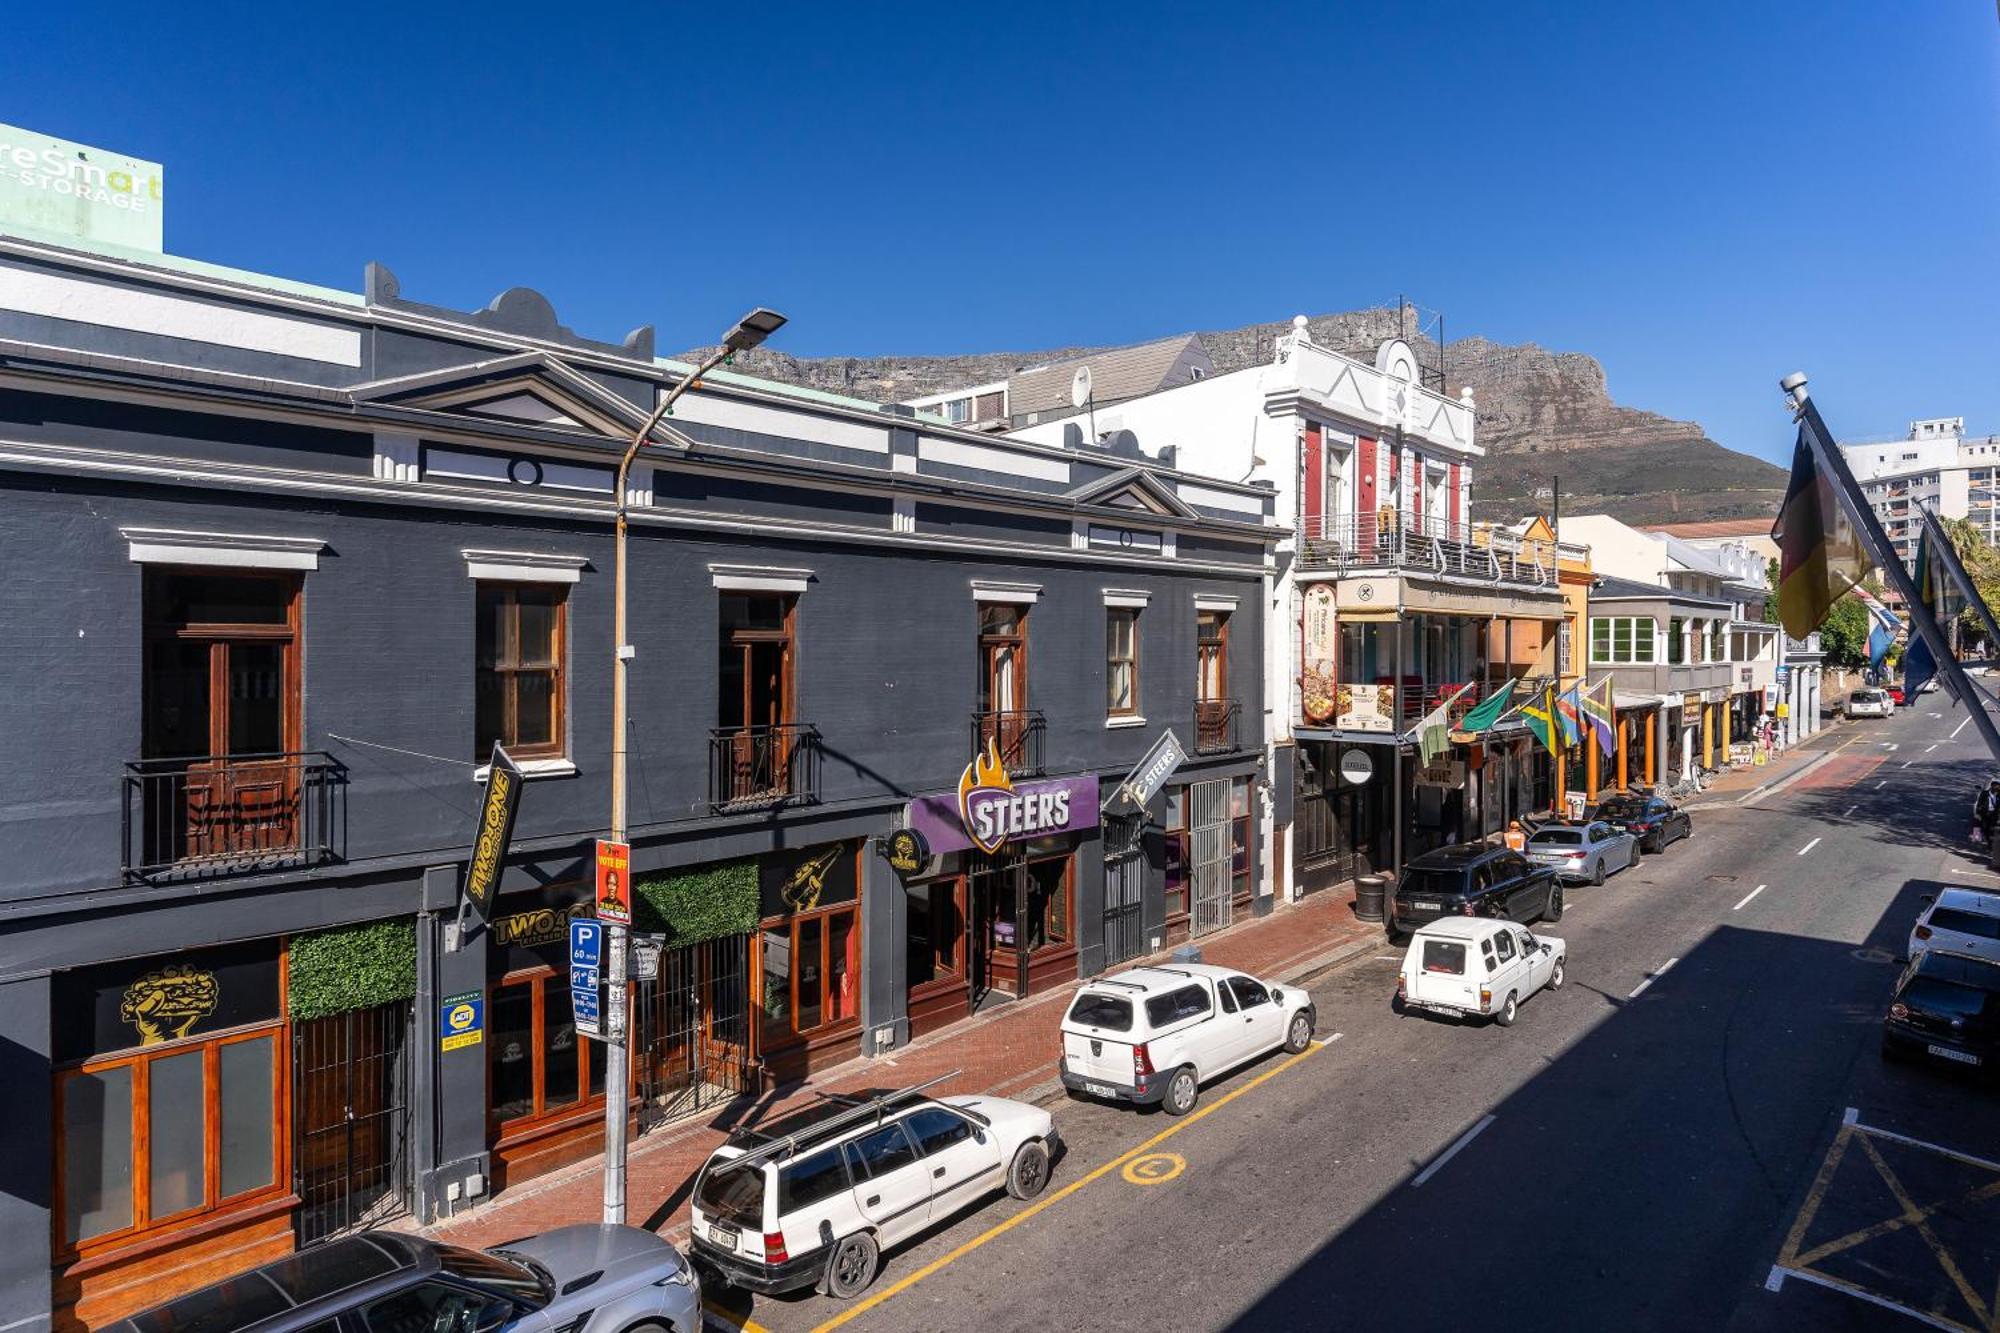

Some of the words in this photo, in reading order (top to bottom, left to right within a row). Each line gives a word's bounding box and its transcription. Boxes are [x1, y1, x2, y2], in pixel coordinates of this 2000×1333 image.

[1146, 750, 1176, 788] STEERS
[976, 791, 1069, 840] STEERS
[598, 856, 614, 868] VOTE
[578, 927, 593, 945] P
[574, 949, 585, 960] 60
[455, 1011, 470, 1022] ADT
